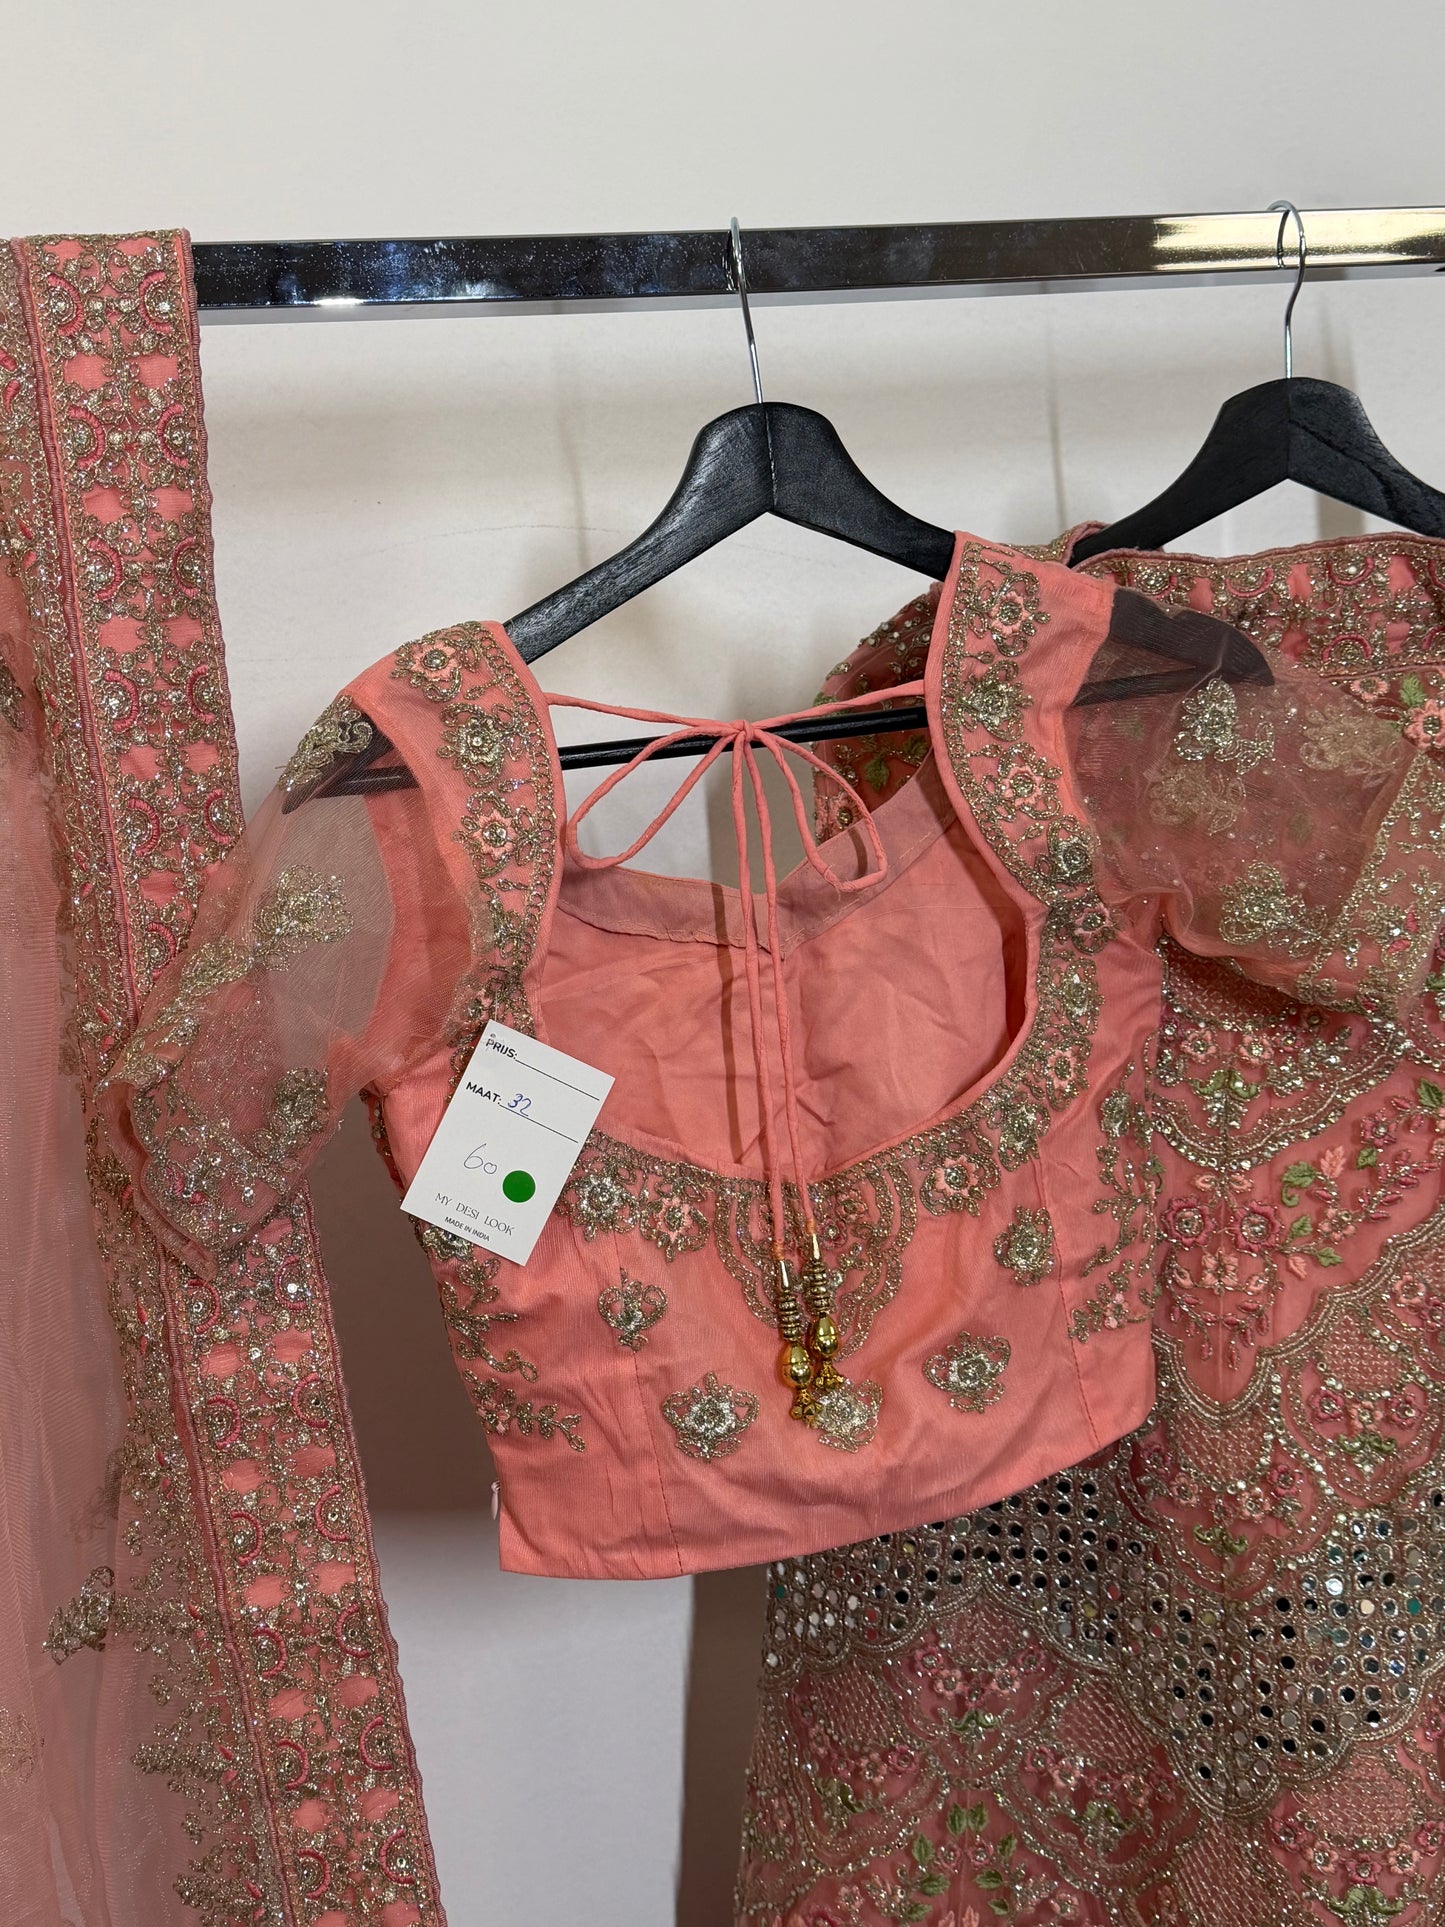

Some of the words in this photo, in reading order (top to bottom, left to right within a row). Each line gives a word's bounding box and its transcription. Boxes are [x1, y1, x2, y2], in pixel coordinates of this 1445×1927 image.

[486, 1038, 517, 1060] PRIJS:
[466, 1081, 502, 1104] MAAT:
[507, 1093, 532, 1117] 32
[463, 1143, 498, 1175] 60
[435, 1192, 453, 1207] MY
[455, 1202, 480, 1220] DESI
[484, 1215, 516, 1236] LOOK
[445, 1216, 464, 1230] MADE
[463, 1225, 472, 1233] IN
[472, 1228, 490, 1241] INDIA
